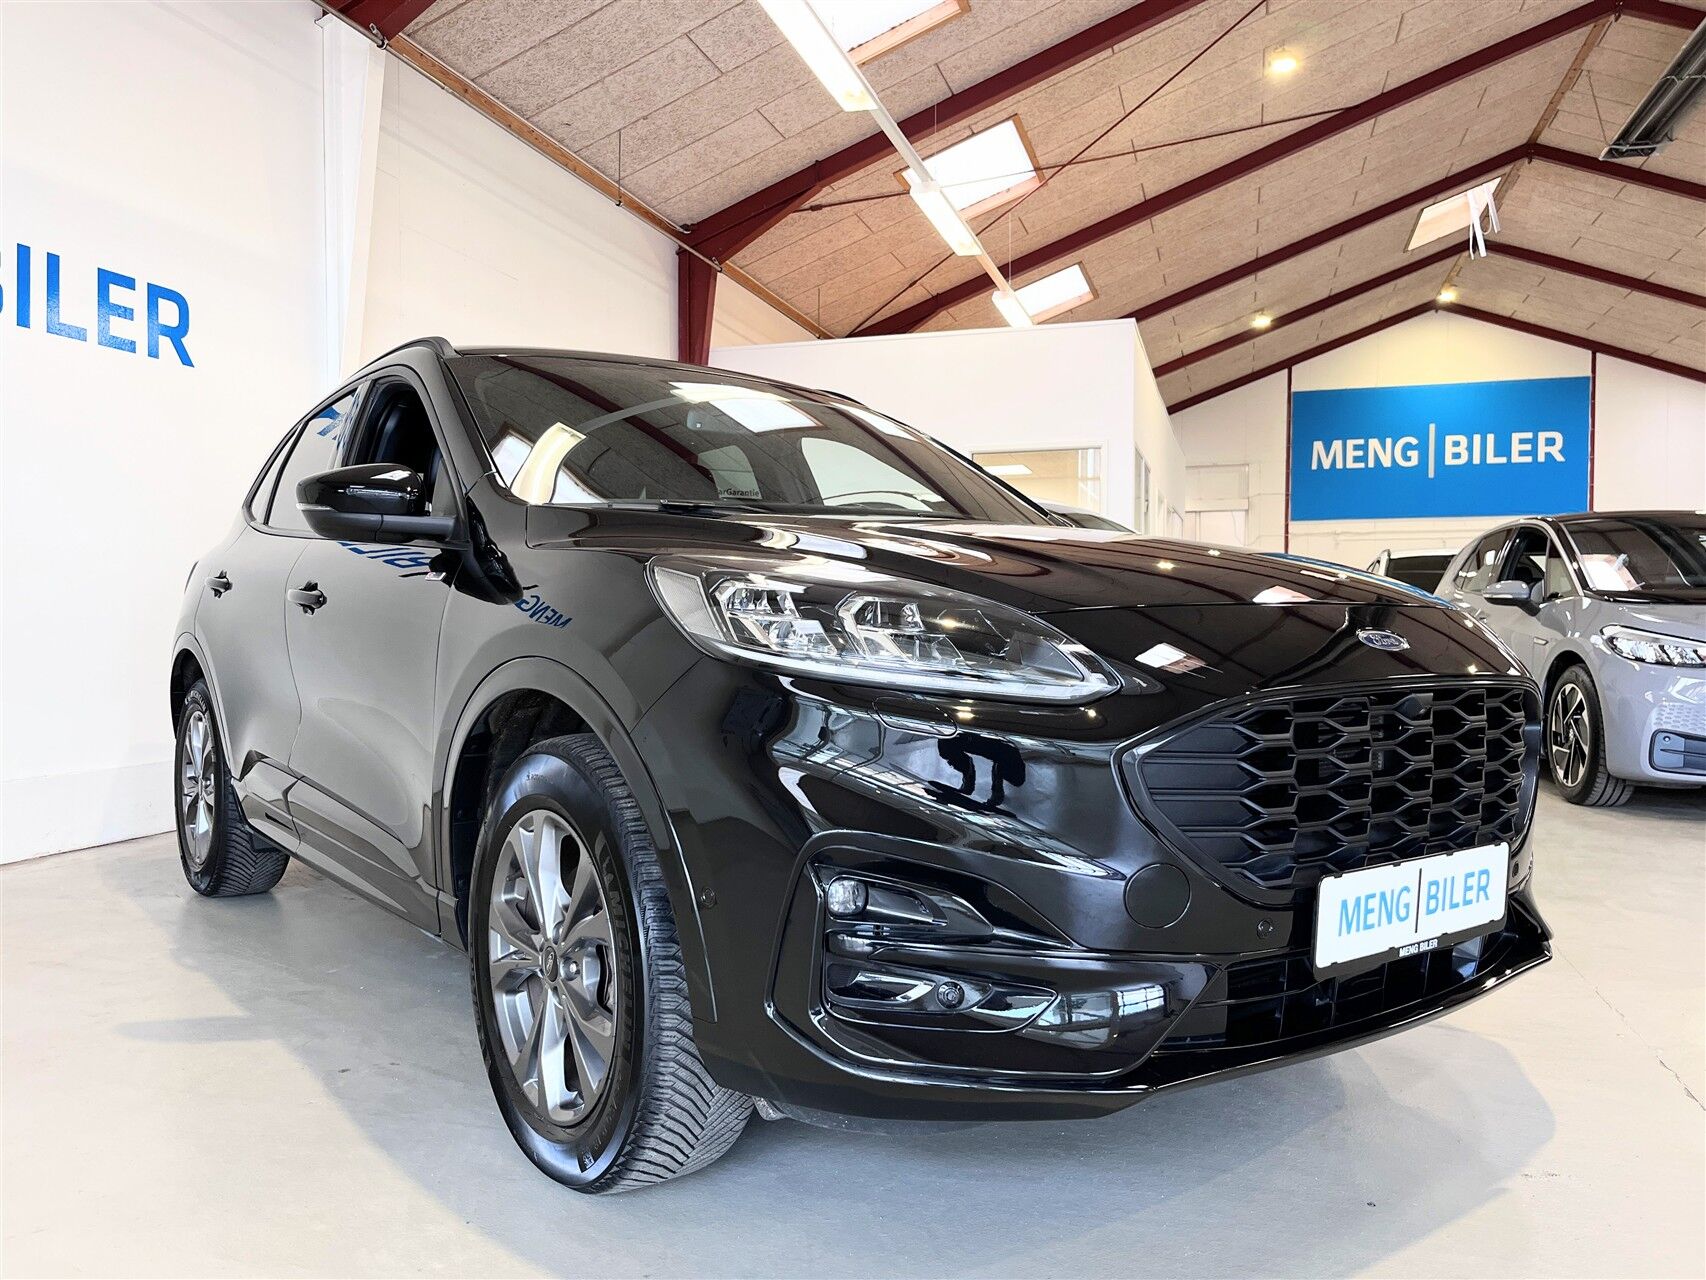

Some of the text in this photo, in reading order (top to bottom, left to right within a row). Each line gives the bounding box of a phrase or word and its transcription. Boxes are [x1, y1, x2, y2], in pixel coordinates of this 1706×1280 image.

[0, 243, 195, 368] ILER
[1311, 431, 1565, 470] MENG BILER
[715, 487, 760, 497] arGarantie
[1338, 868, 1490, 937] MENG BILER
[1399, 939, 1438, 957] MENG BILER
